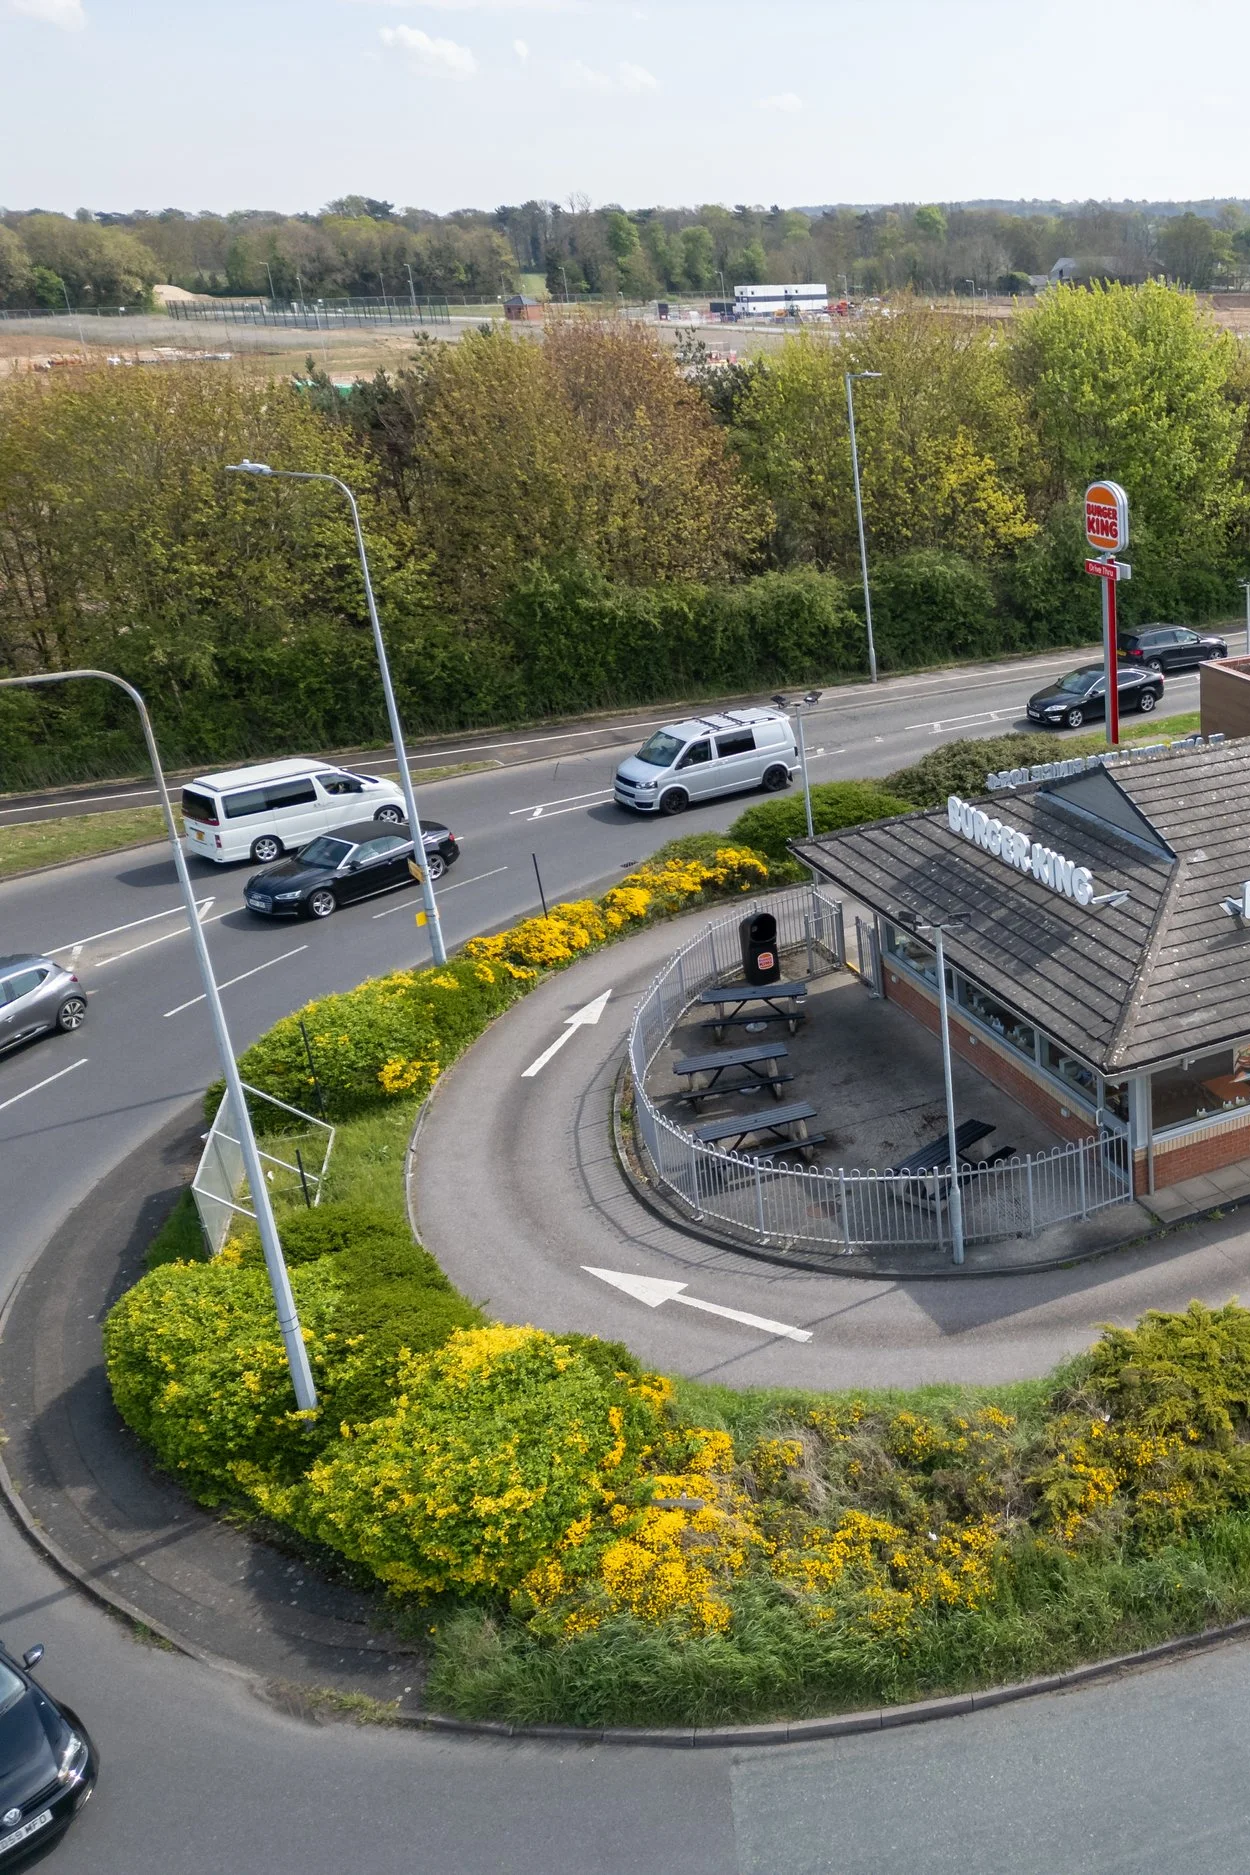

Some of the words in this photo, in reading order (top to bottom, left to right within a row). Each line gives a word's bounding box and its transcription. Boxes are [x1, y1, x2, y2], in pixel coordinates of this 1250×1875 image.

[1086, 503, 1118, 521] BURGER
[1087, 516, 1118, 538] KING
[1088, 563, 1102, 574] Drive
[1102, 566, 1114, 577] Thru
[948, 795, 1031, 872] BURGER
[1031, 842, 1094, 906] KING
